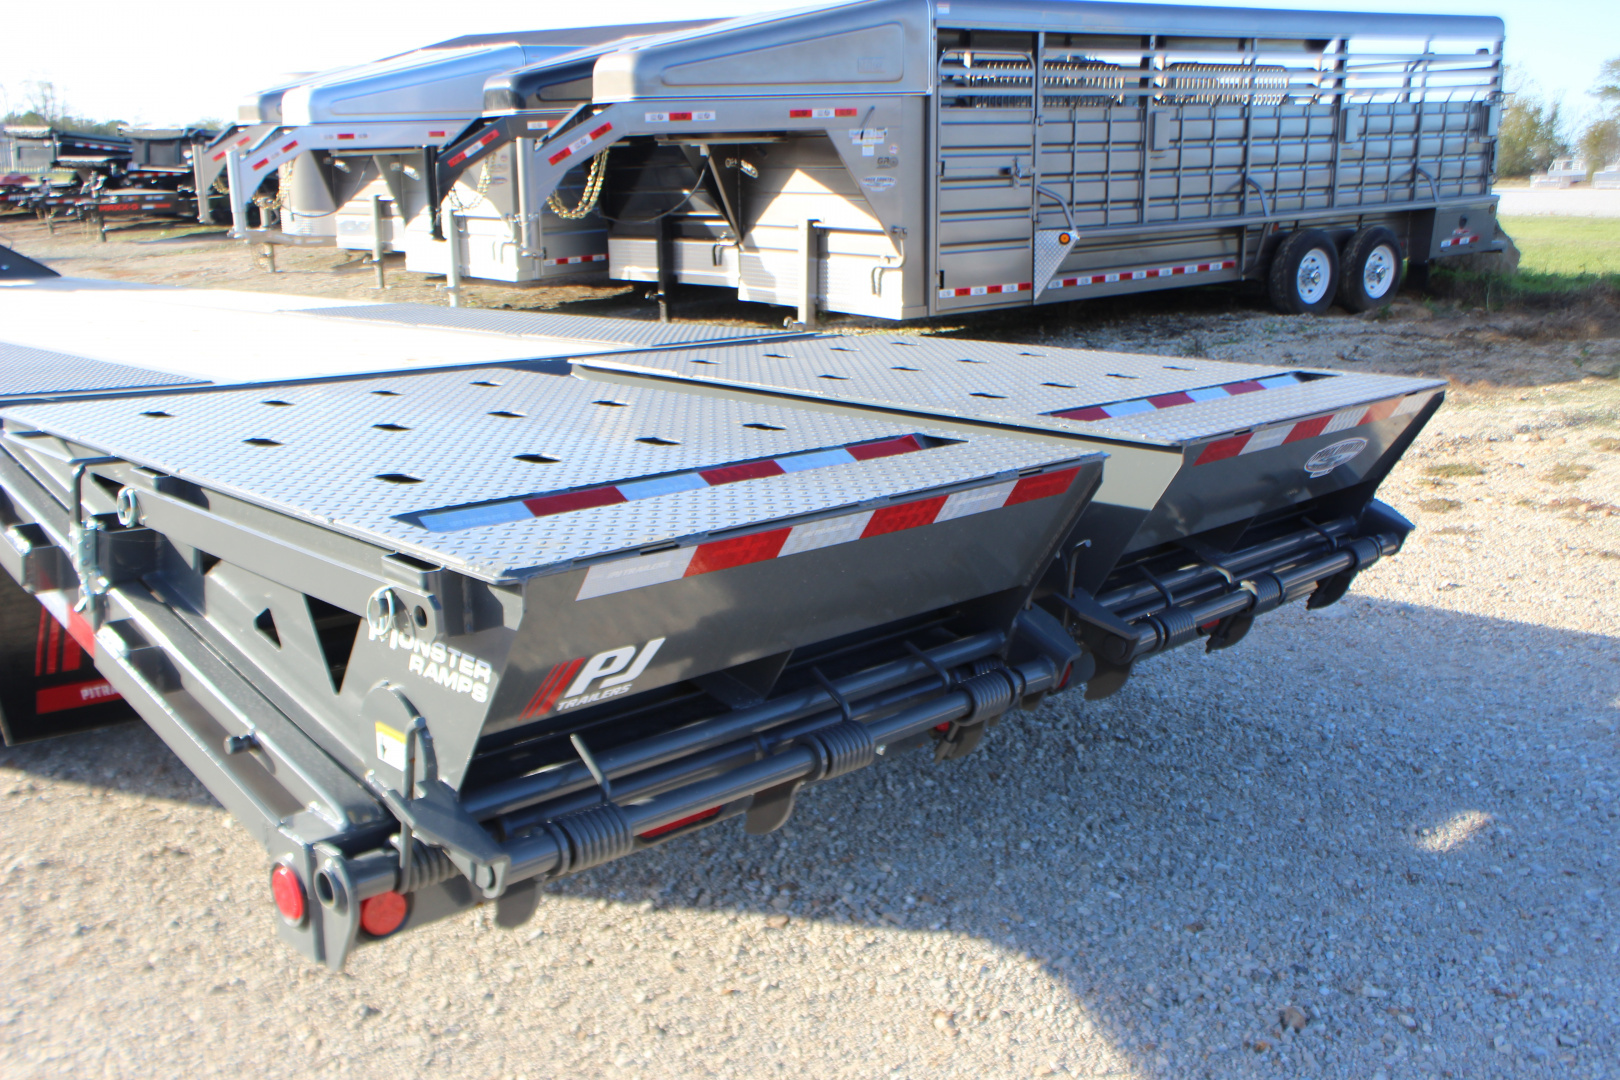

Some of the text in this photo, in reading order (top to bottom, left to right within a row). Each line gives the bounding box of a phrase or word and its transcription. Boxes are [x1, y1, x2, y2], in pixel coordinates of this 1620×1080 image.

[408, 653, 489, 703] RAMPS
[564, 637, 666, 699] PJ
[556, 684, 633, 712] TRAILERS
